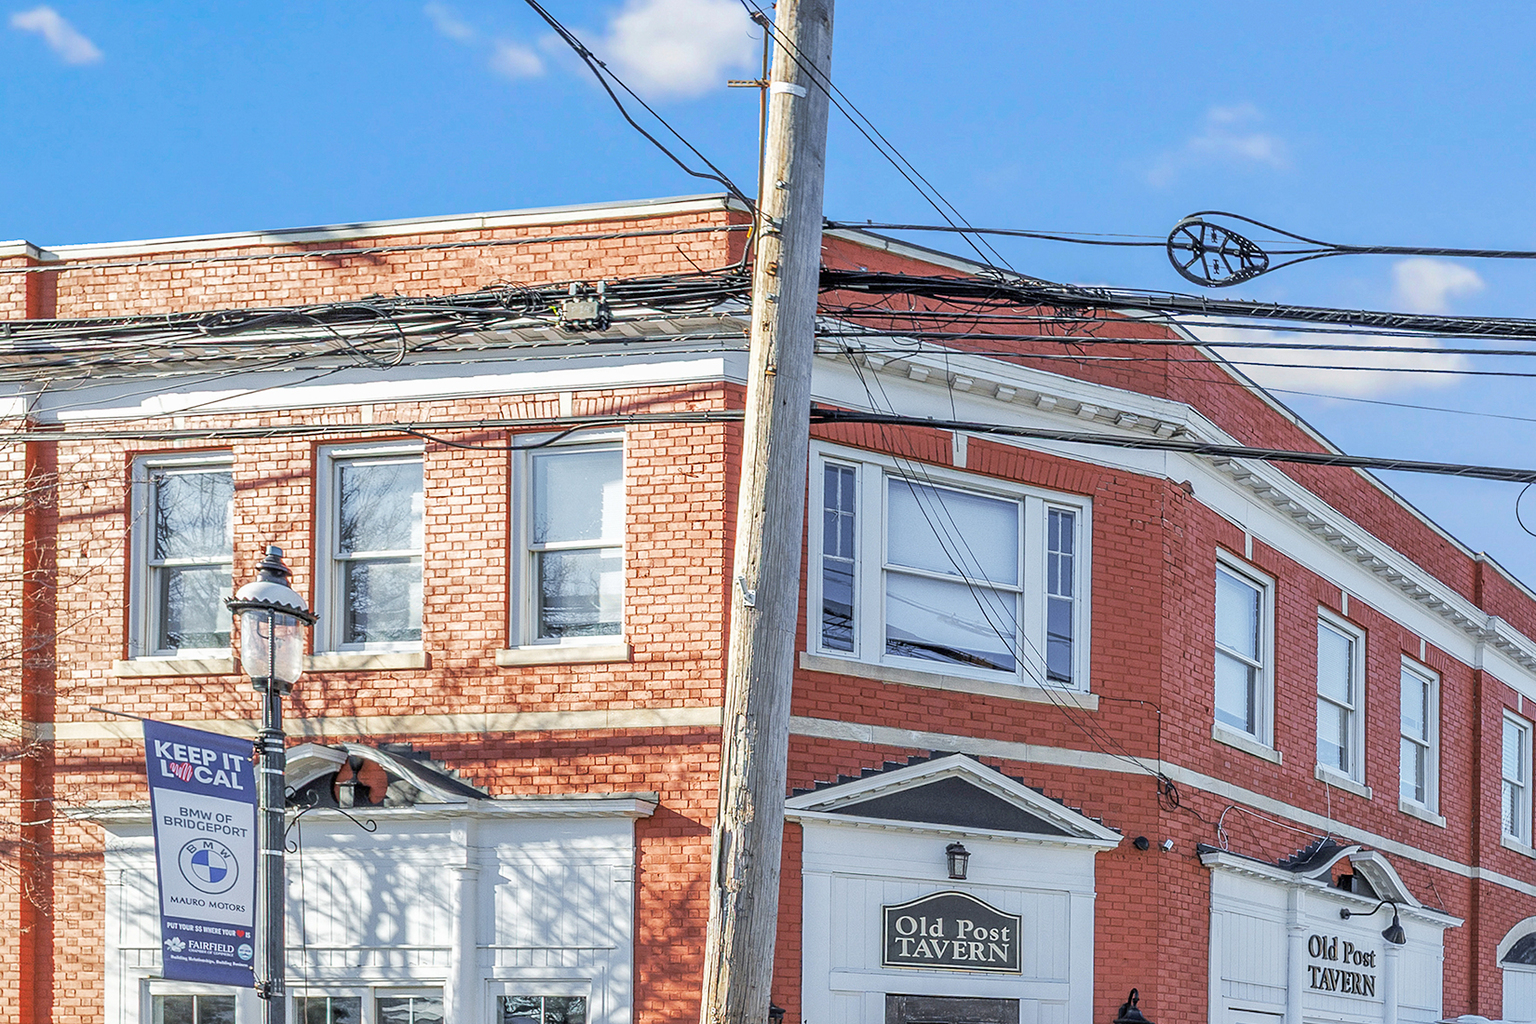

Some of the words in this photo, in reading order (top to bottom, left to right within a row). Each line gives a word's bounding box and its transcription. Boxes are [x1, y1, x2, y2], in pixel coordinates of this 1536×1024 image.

[154, 740, 217, 766] KEEP
[222, 752, 244, 772] IT
[179, 807, 212, 821] BMW
[215, 813, 233, 824] OF
[163, 816, 248, 837] BRIDGEPORT
[186, 841, 231, 859] BMW
[170, 895, 206, 907] MAURO
[208, 901, 246, 913] MOTORS
[166, 921, 178, 929] PUT
[179, 923, 194, 931] YOUR
[203, 926, 221, 935] WHERE
[895, 915, 944, 937] Old
[956, 919, 1010, 941] Post
[188, 940, 235, 953] FAIRFIELD
[894, 937, 1010, 962] TAVERN
[1308, 934, 1338, 961] Old
[1342, 940, 1376, 968] Post
[1308, 965, 1376, 997] TAVERN
